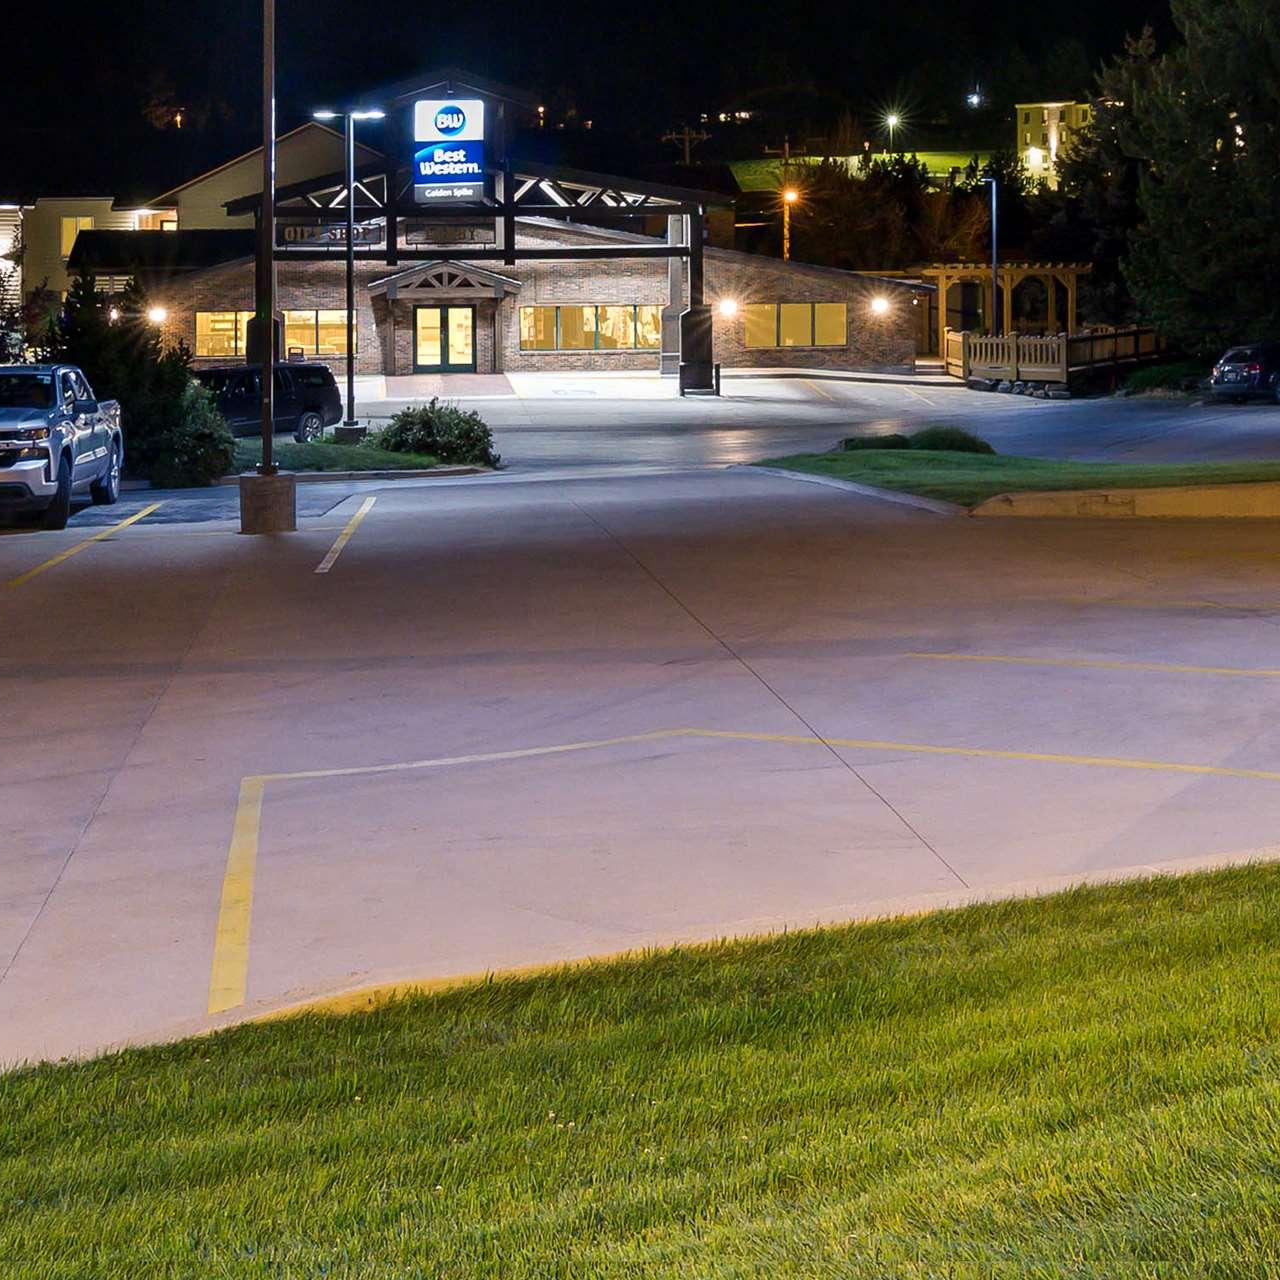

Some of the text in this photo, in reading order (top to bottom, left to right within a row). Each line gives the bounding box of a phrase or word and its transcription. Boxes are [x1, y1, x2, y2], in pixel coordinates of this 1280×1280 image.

[437, 113, 464, 129] BW
[433, 148, 466, 162] Best
[425, 188, 452, 198] Golden
